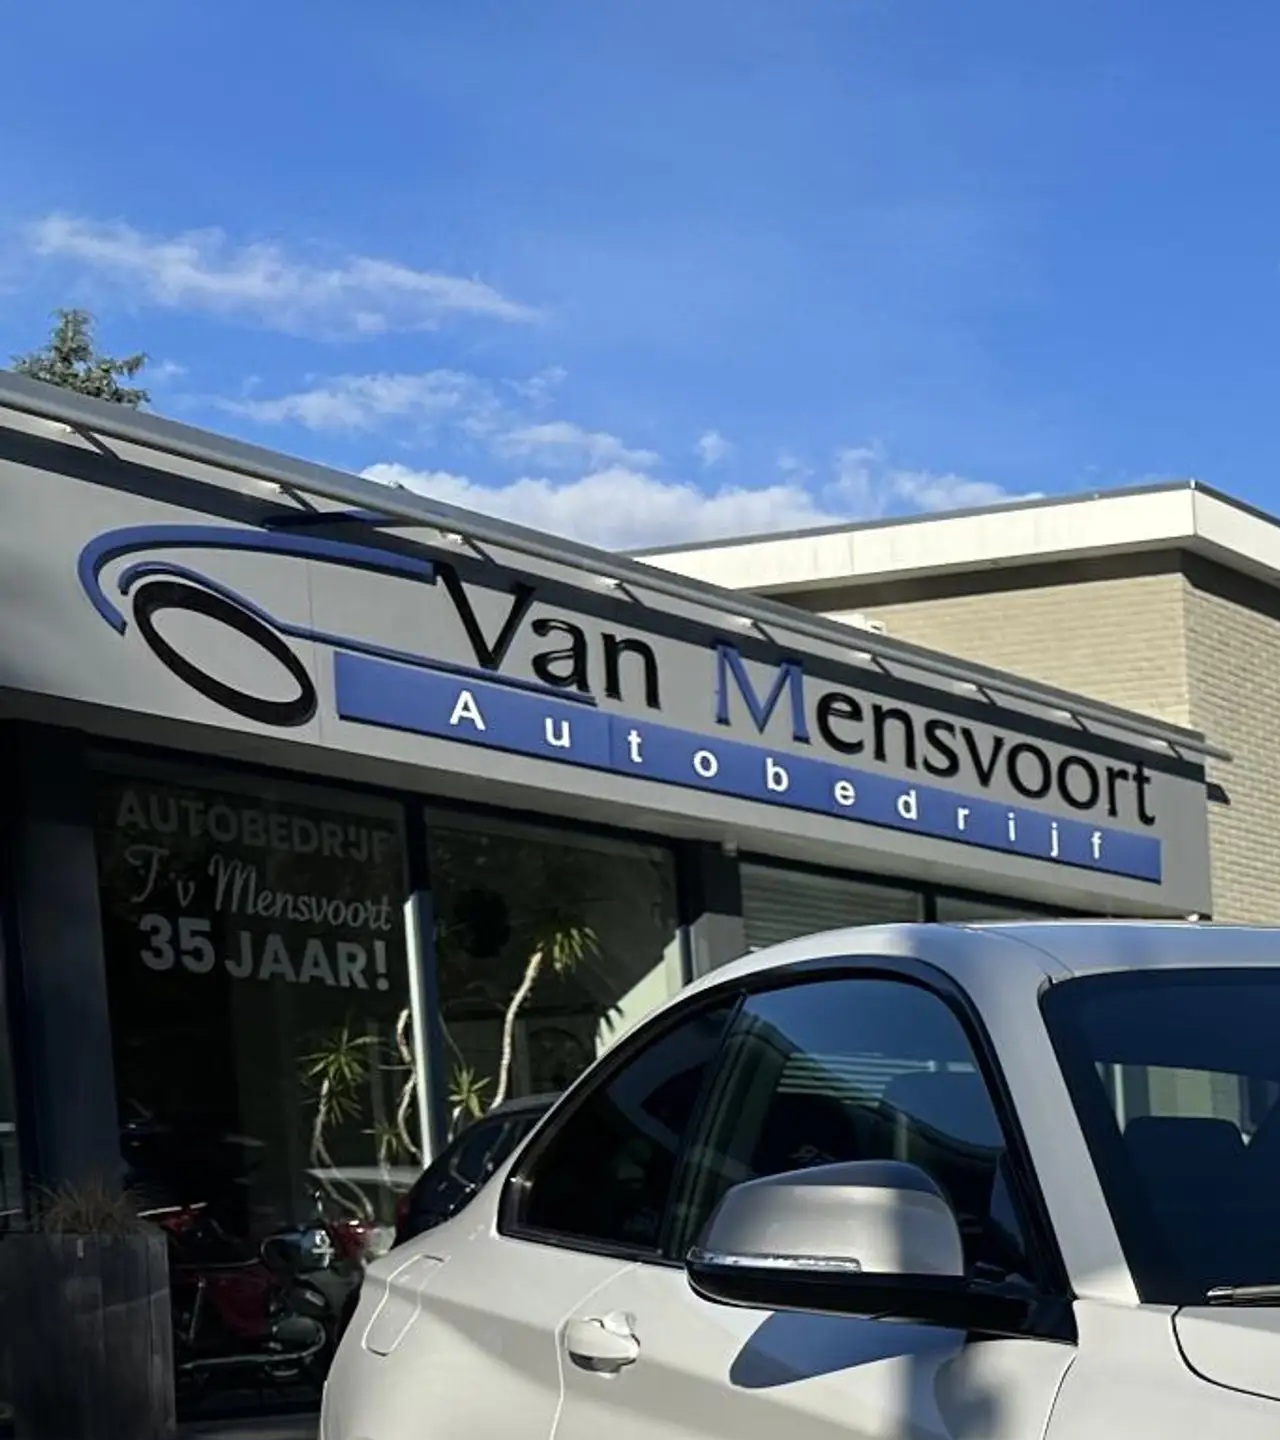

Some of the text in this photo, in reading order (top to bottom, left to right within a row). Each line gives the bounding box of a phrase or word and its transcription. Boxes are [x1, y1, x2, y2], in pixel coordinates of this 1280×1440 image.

[435, 560, 1156, 826] Van Mensvoort
[449, 690, 1103, 860] Autobedrijf
[116, 790, 396, 864] AUTOBEDRIJF
[207, 853, 393, 932] Mensvoort
[138, 913, 390, 992] 35 JAAR!
